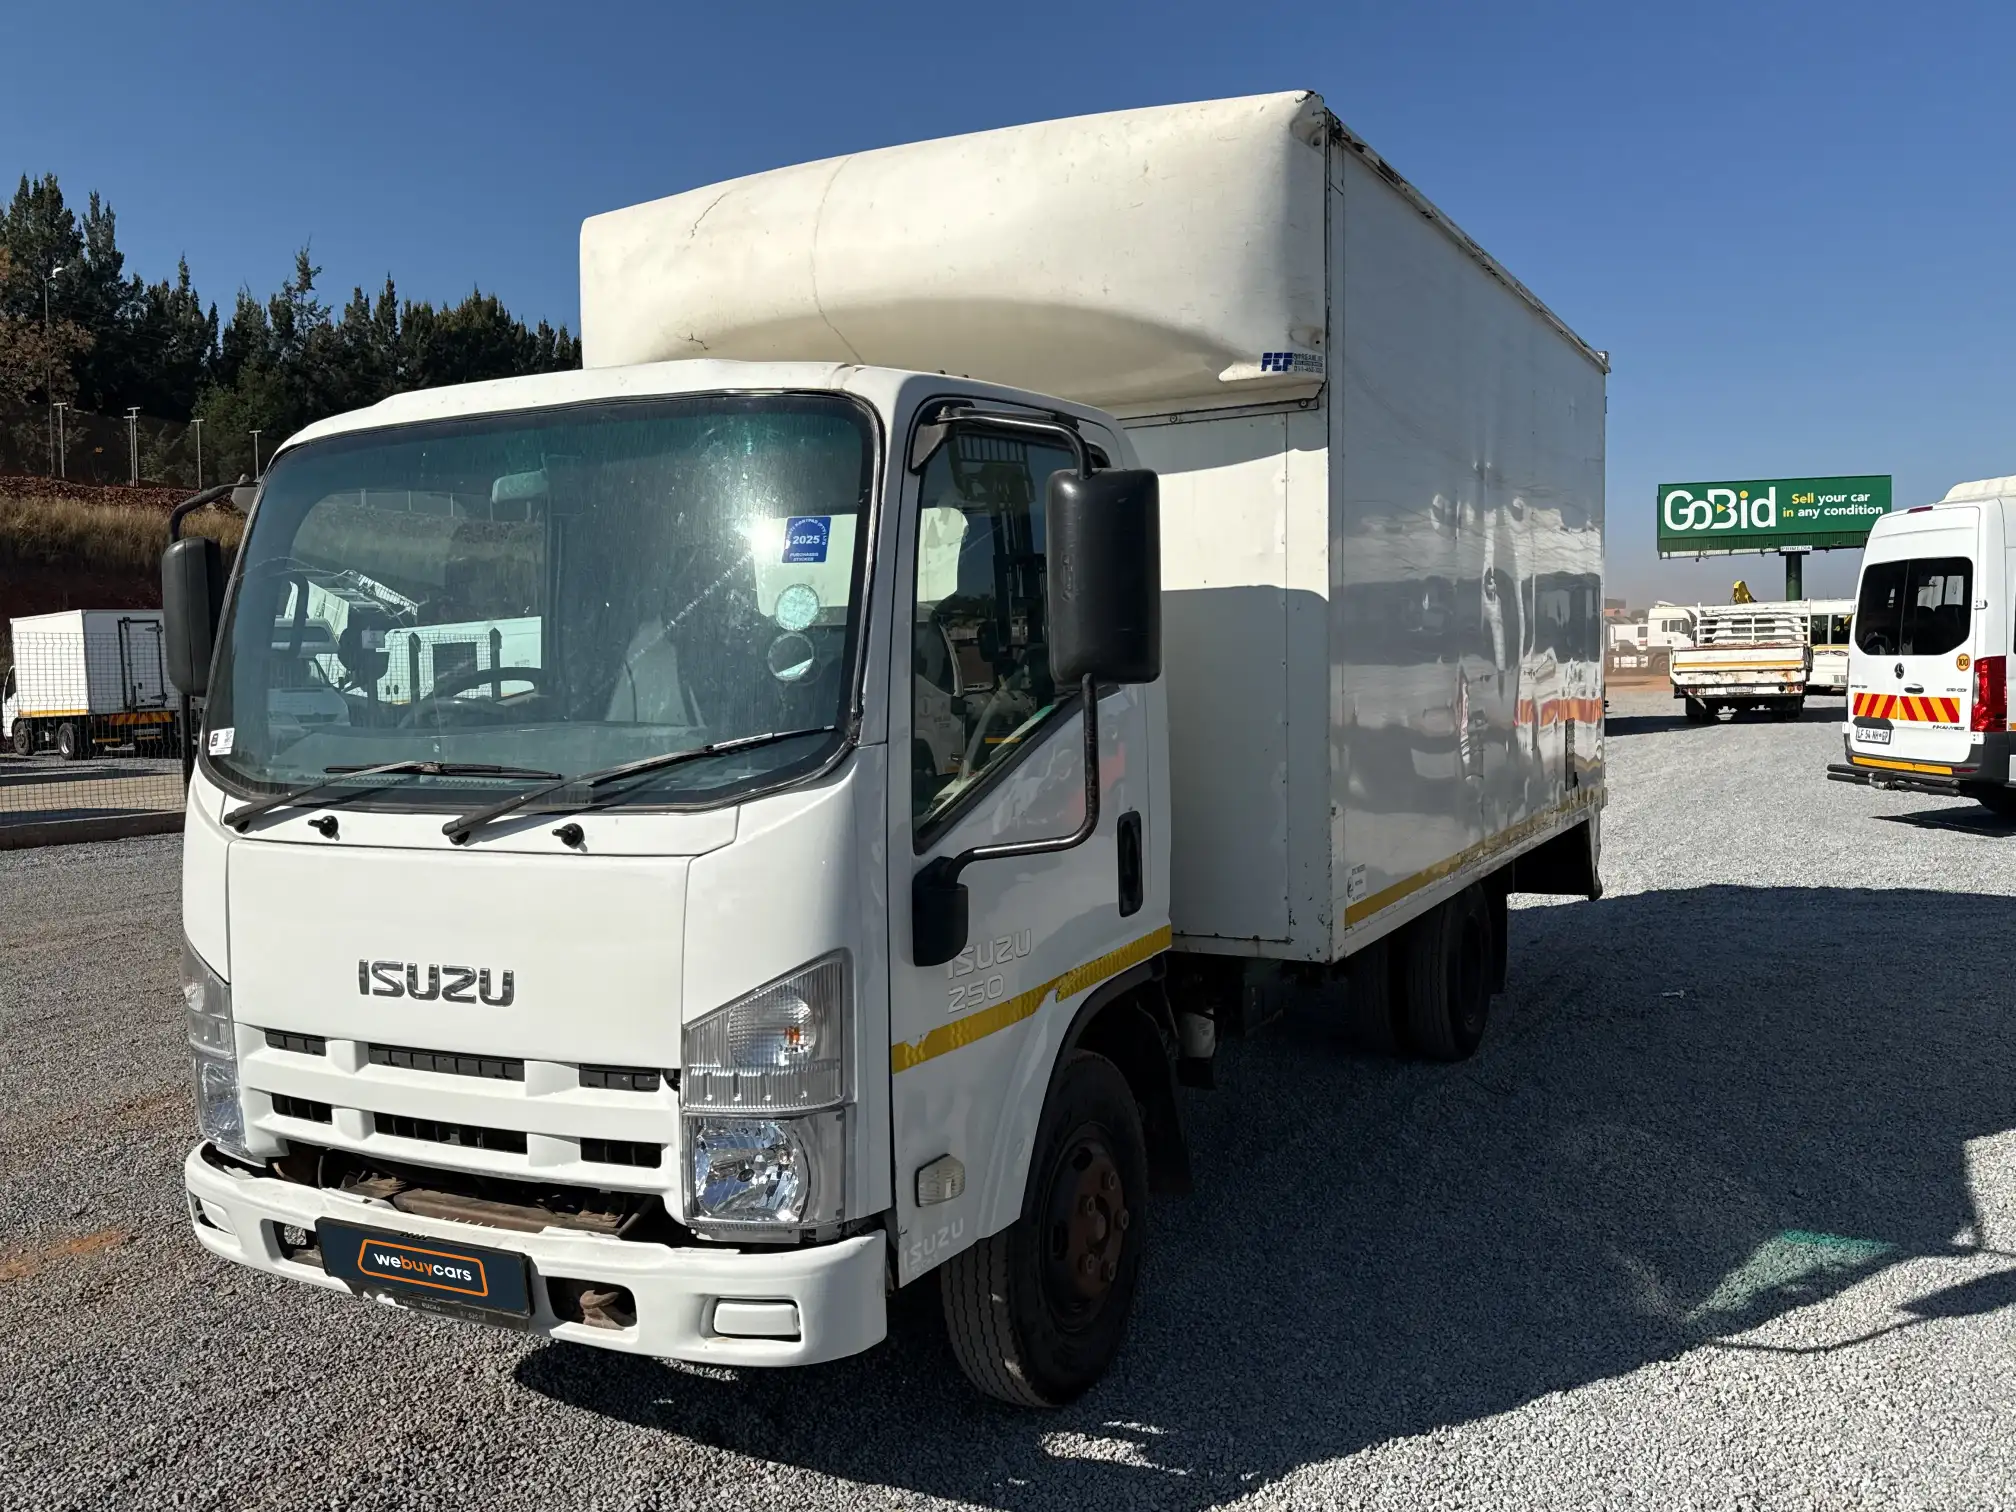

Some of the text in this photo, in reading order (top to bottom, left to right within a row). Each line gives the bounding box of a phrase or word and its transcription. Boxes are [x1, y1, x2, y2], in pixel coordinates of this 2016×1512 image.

[1664, 486, 1777, 531] GoBid
[1783, 504, 1884, 519] in any condition
[1791, 491, 1871, 506] Sell your car
[792, 535, 820, 545] 2025
[1958, 658, 1969, 667] 100
[947, 928, 1032, 980] ISUZU
[358, 958, 515, 1008] ISUZU
[903, 1217, 964, 1272] ISUZU
[373, 1253, 473, 1282] webuycars
